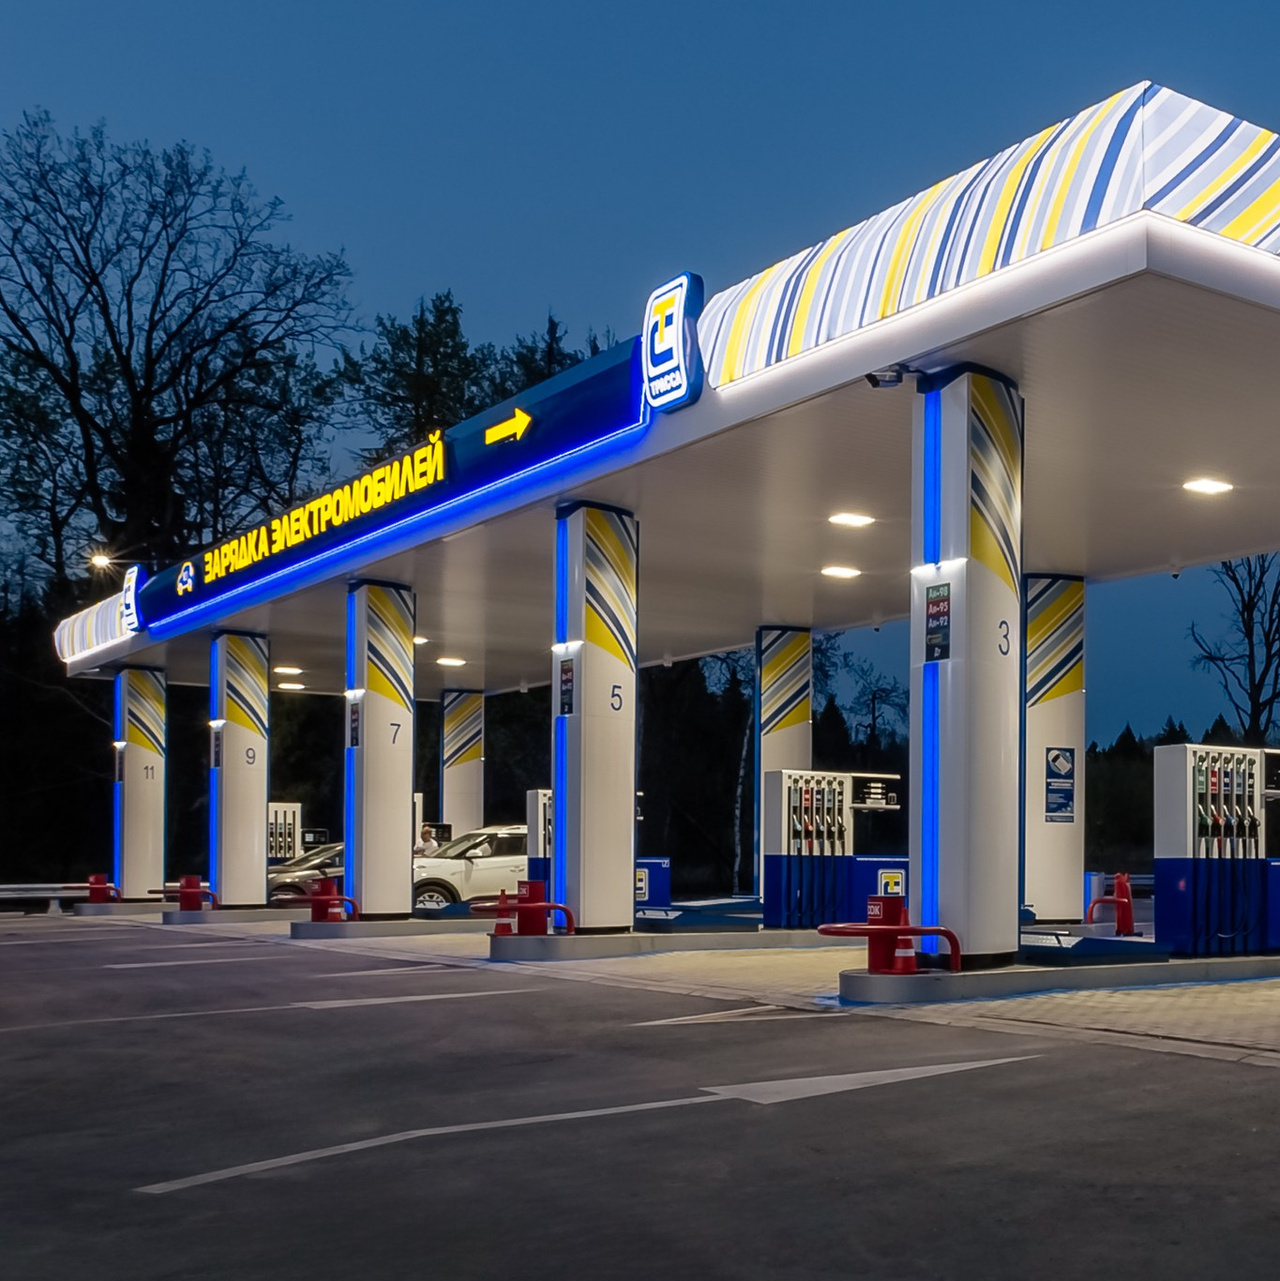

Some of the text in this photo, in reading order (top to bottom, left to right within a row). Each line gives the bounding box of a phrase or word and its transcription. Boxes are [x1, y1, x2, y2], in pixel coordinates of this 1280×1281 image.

[649, 370, 682, 396] ТРАССА
[204, 430, 444, 584] ЗАРЯДКА ЭЛЕКТРОМОБИЛЕЙ
[998, 620, 1010, 656] 3
[610, 684, 623, 712] 5
[390, 723, 401, 745] 7
[245, 747, 256, 765] 9
[143, 765, 155, 780] 11
